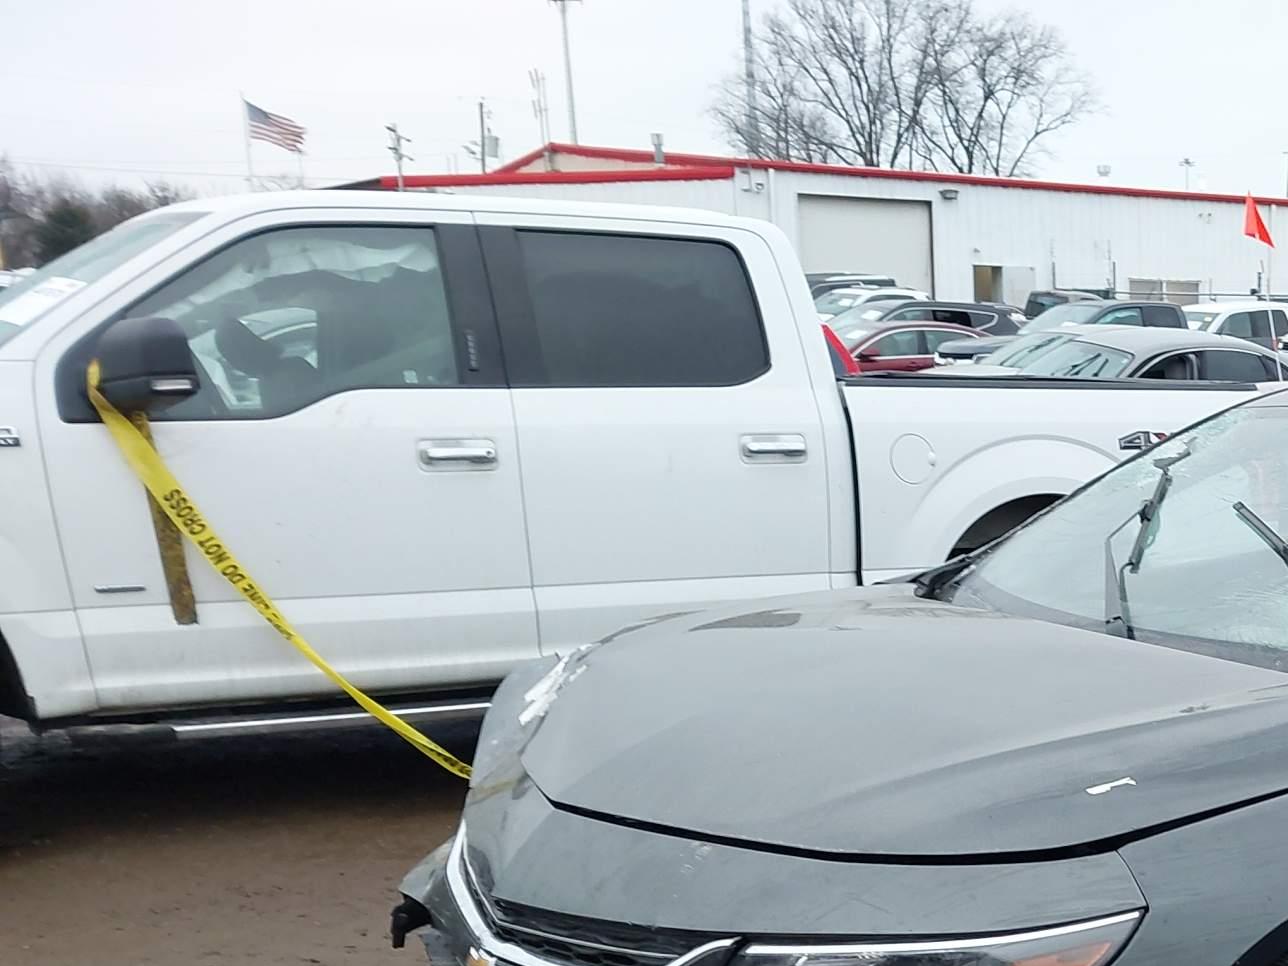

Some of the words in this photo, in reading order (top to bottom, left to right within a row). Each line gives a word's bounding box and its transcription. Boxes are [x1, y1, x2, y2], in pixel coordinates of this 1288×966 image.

[162, 487, 206, 536] CROSS
[197, 536, 232, 566] NOT
[221, 563, 247, 586] DO
